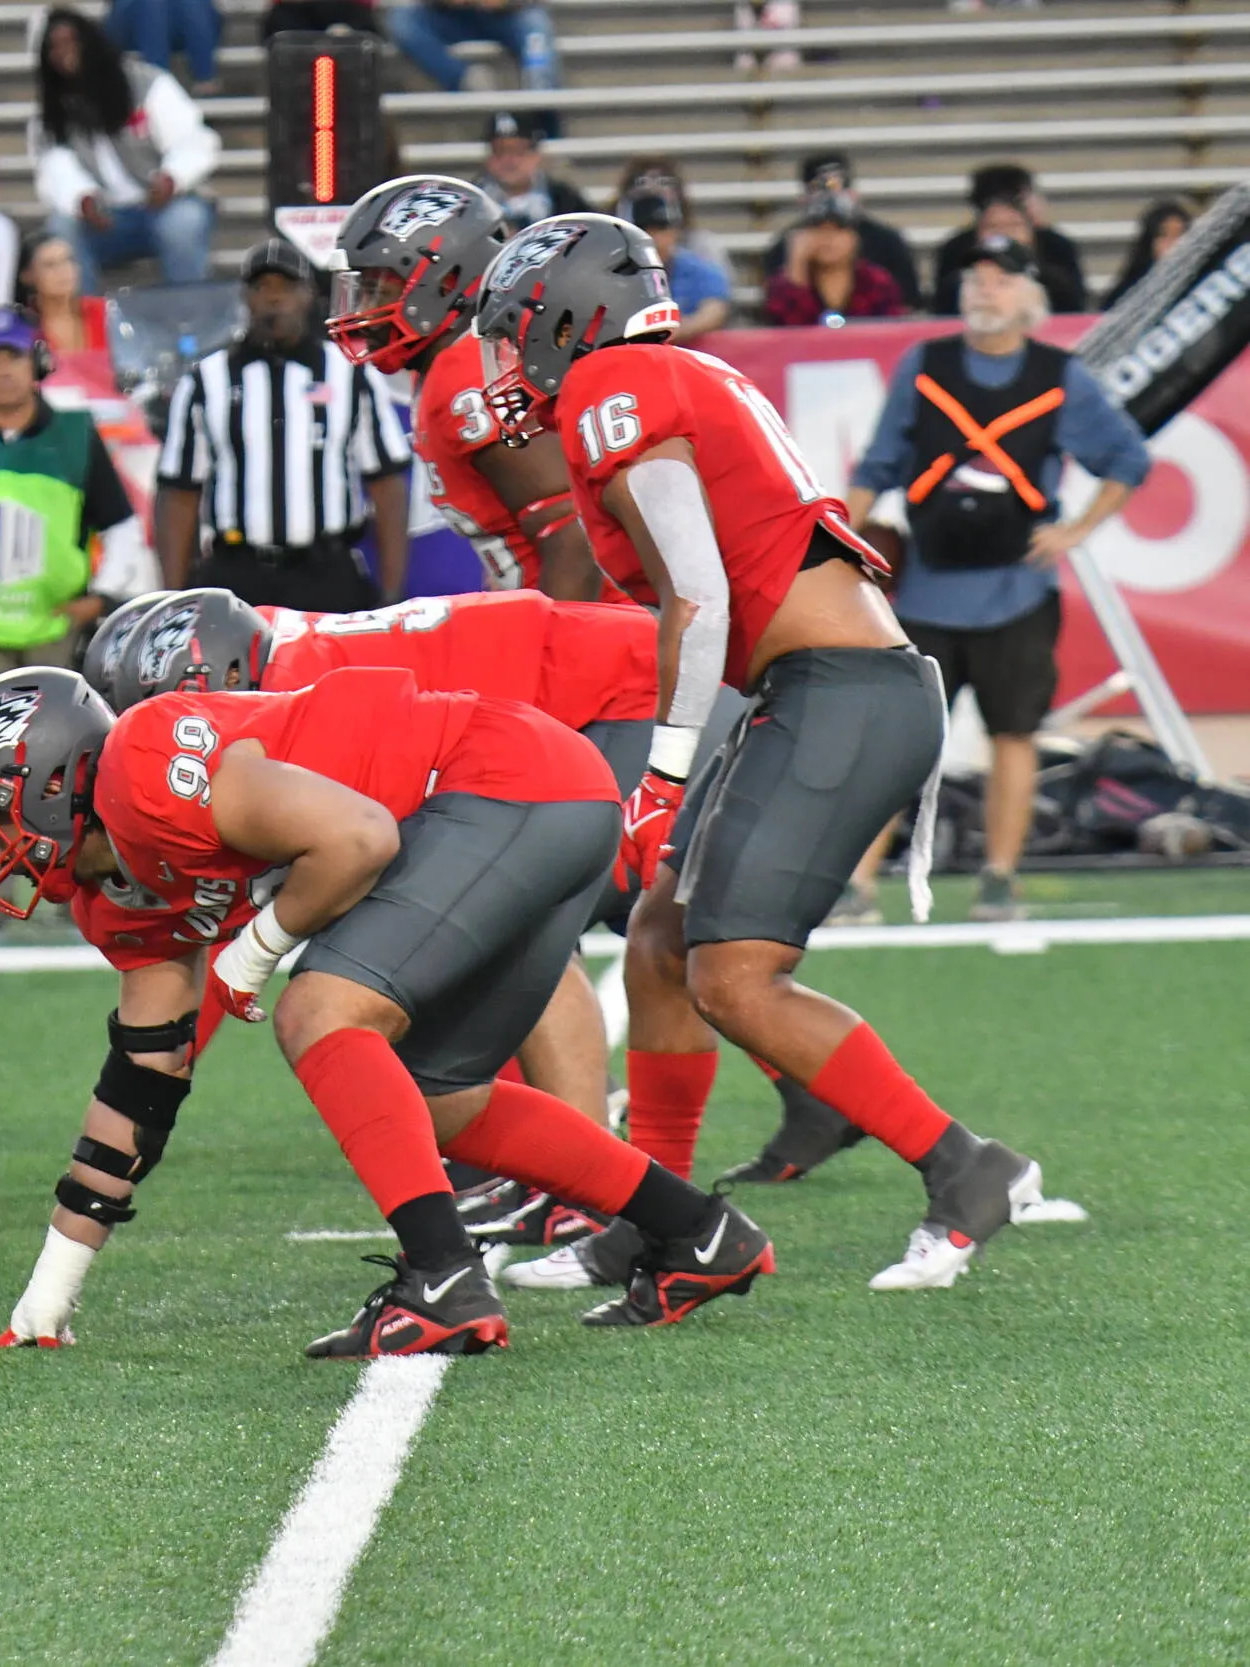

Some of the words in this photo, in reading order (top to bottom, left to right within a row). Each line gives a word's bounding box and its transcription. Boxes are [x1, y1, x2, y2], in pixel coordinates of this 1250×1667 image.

[1103, 242, 1250, 411] OGERS
[450, 386, 495, 443] 3
[576, 391, 643, 468] 16
[166, 715, 220, 808] 99
